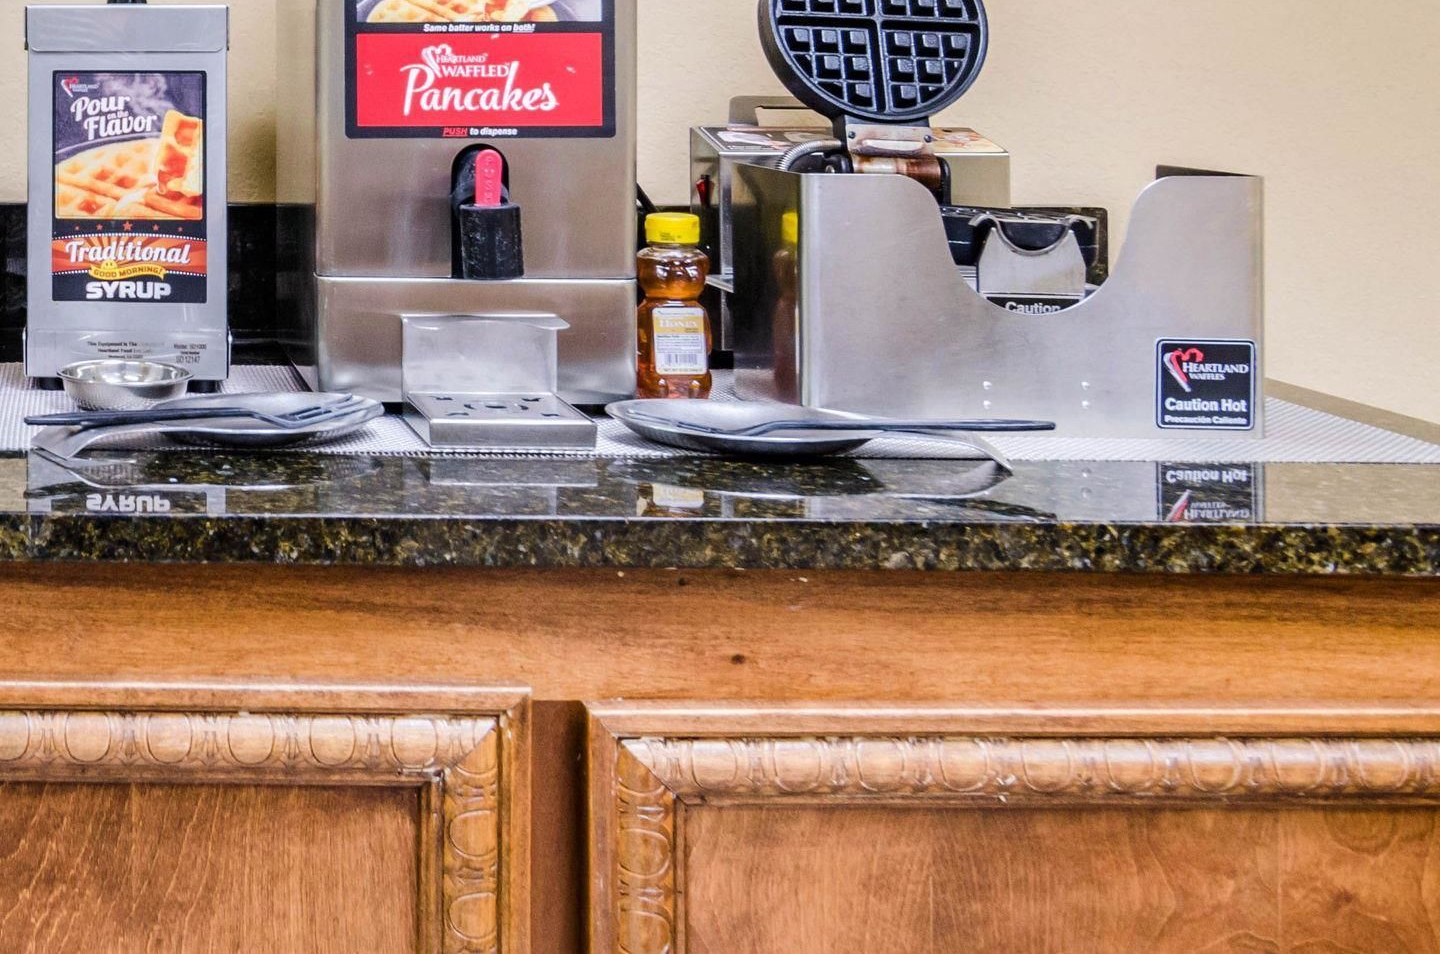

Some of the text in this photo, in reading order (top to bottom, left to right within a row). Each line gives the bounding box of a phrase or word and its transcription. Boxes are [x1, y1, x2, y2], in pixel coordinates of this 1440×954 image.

[423, 23, 447, 32] Same
[448, 23, 474, 32] batter
[474, 23, 499, 32] works
[512, 23, 535, 33] both!
[436, 54, 486, 63] HEARTLAND
[441, 64, 510, 77] WAFFLED
[399, 60, 560, 116] Pancakes
[70, 96, 131, 122] Pour
[117, 110, 129, 118] the
[83, 115, 158, 141] Flavor
[443, 127, 517, 137] PUSH to dispense
[65, 240, 191, 264] Traditional
[93, 265, 163, 278] GOOD MORNING!
[85, 281, 172, 300] SYRUP
[1182, 362, 1249, 373] HEARTLAND
[1164, 397, 1248, 412] Caution Hot
[1212, 416, 1248, 424] Caliente
